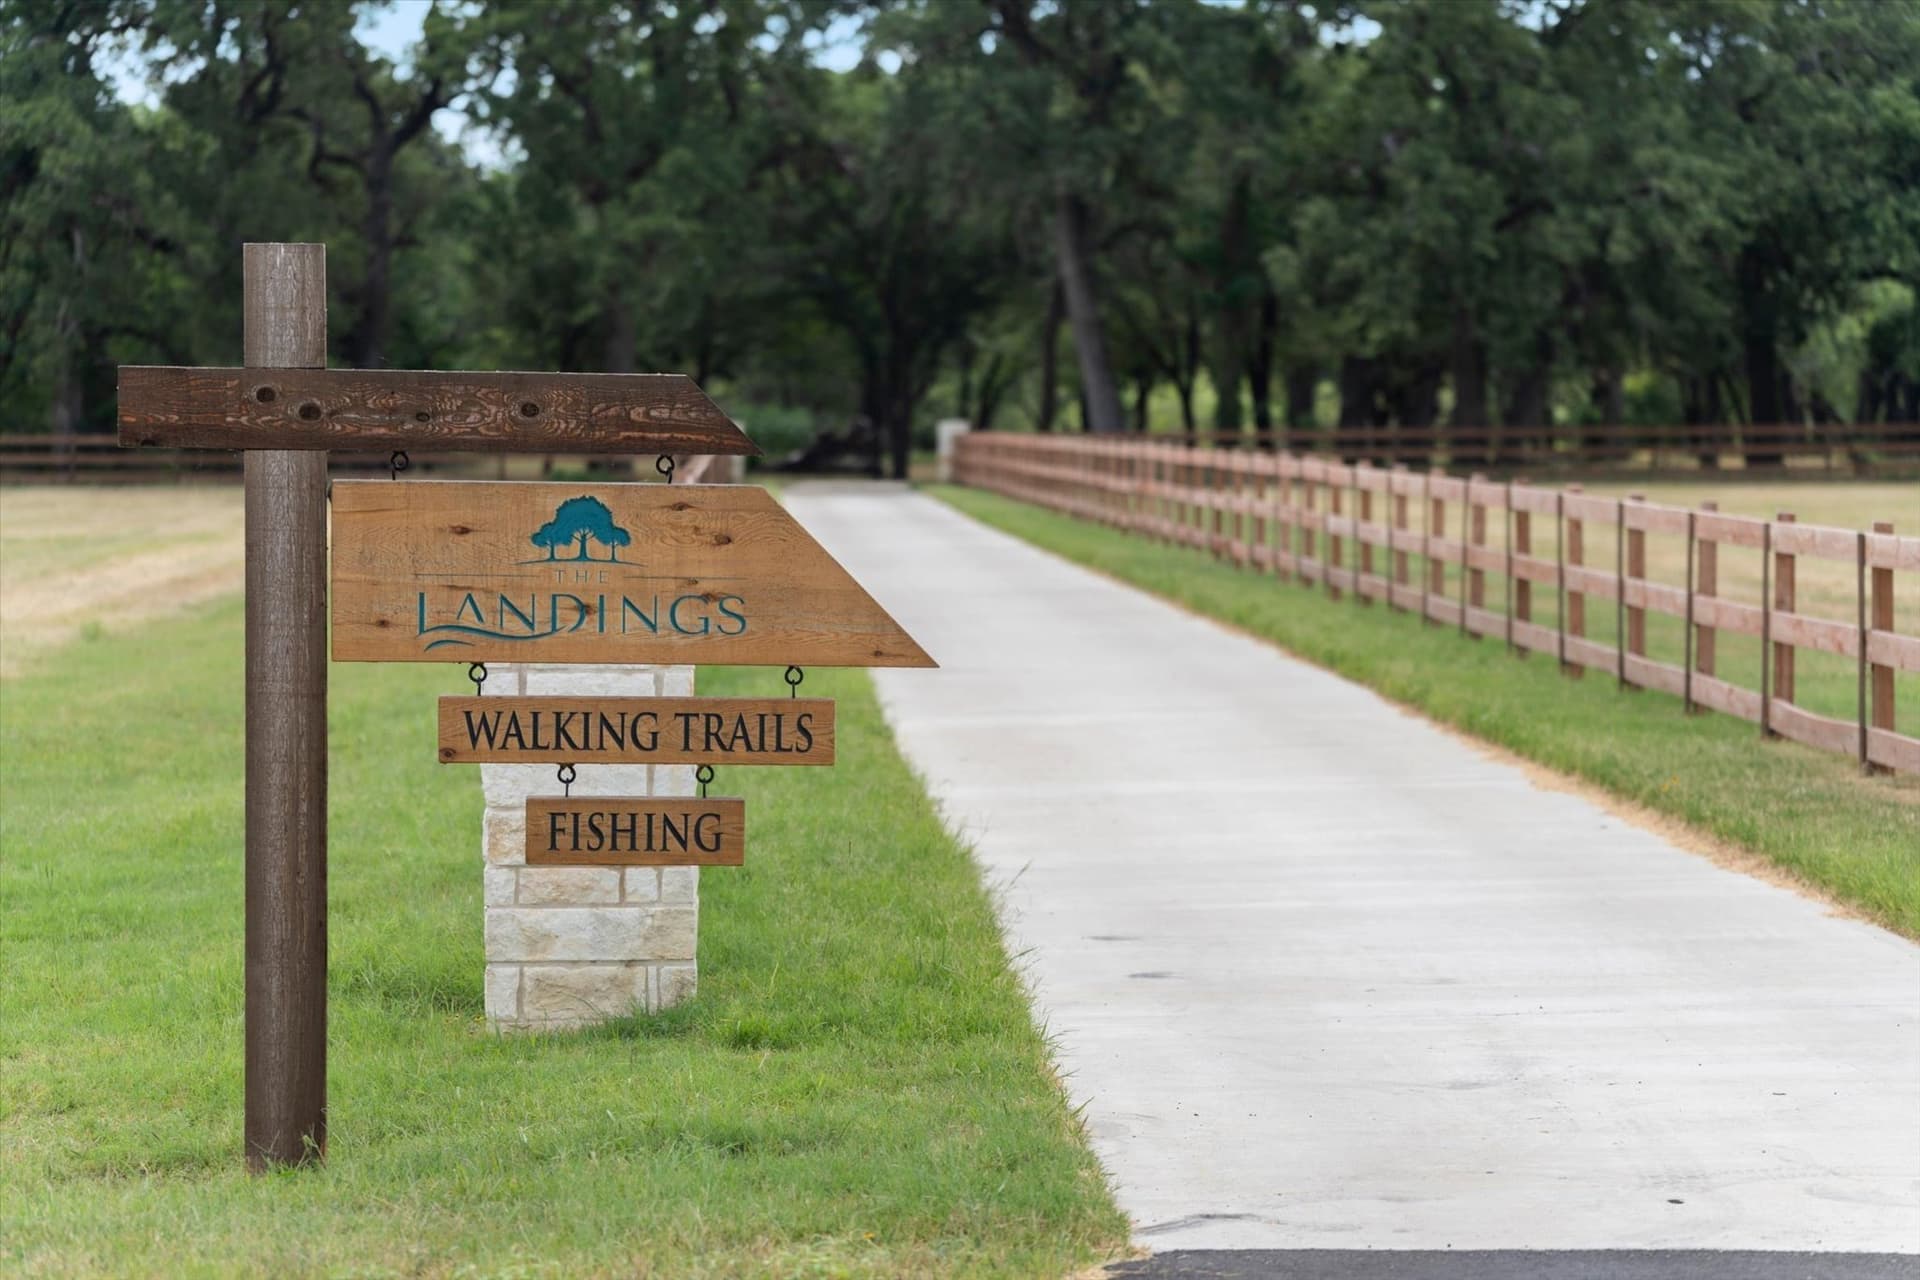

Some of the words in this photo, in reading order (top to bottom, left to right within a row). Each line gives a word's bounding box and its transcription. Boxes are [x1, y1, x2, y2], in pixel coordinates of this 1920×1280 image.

[554, 569, 609, 584] THE
[417, 591, 747, 640] LANDINGS
[464, 710, 659, 752] WALKING
[674, 712, 814, 753] TRAILS
[546, 811, 723, 853] FISHING
